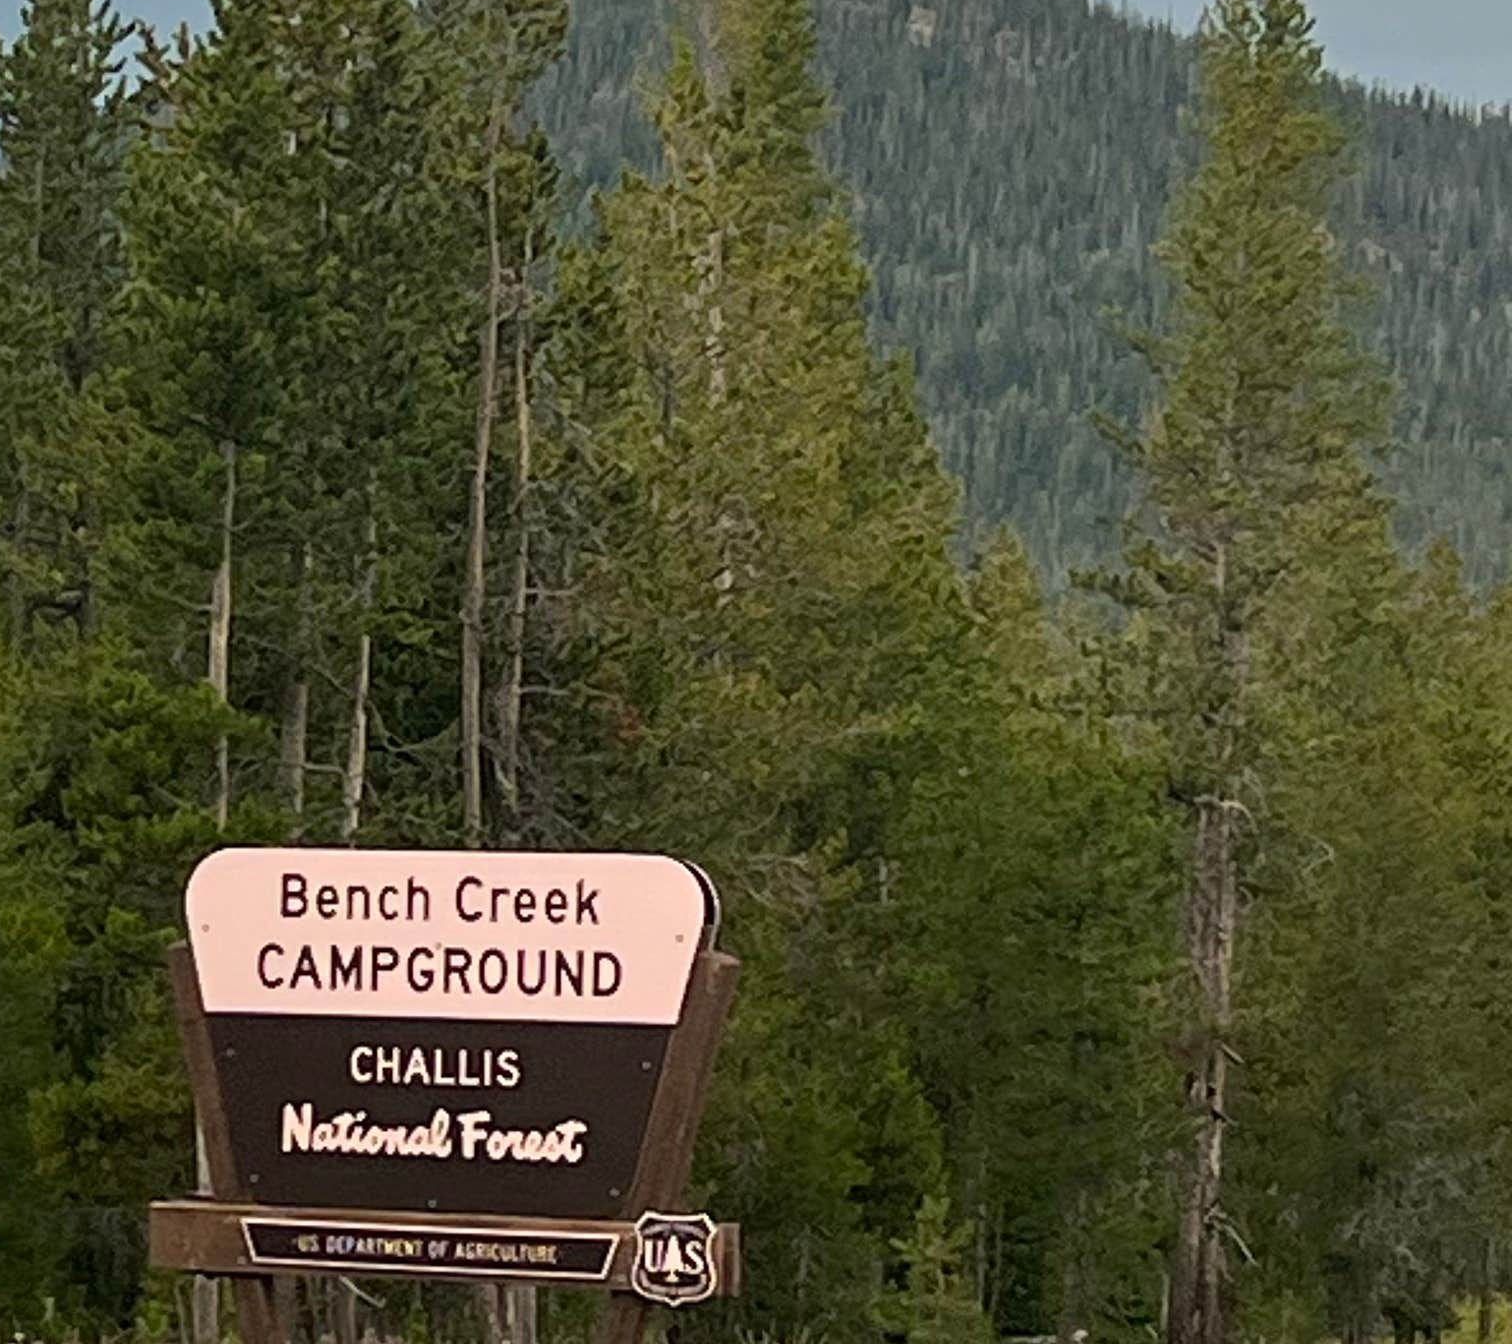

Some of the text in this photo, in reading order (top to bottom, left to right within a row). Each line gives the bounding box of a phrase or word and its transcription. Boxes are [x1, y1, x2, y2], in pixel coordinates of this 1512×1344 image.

[280, 873, 600, 924] Bench Creek
[257, 942, 622, 997] CAMPGROUND
[350, 1046, 521, 1087] CHALLIS
[282, 1103, 587, 1163] National Forest
[325, 1235, 424, 1258] DEPARTMENT
[427, 1240, 449, 1258] OF
[454, 1241, 558, 1264] AGRICULTURE
